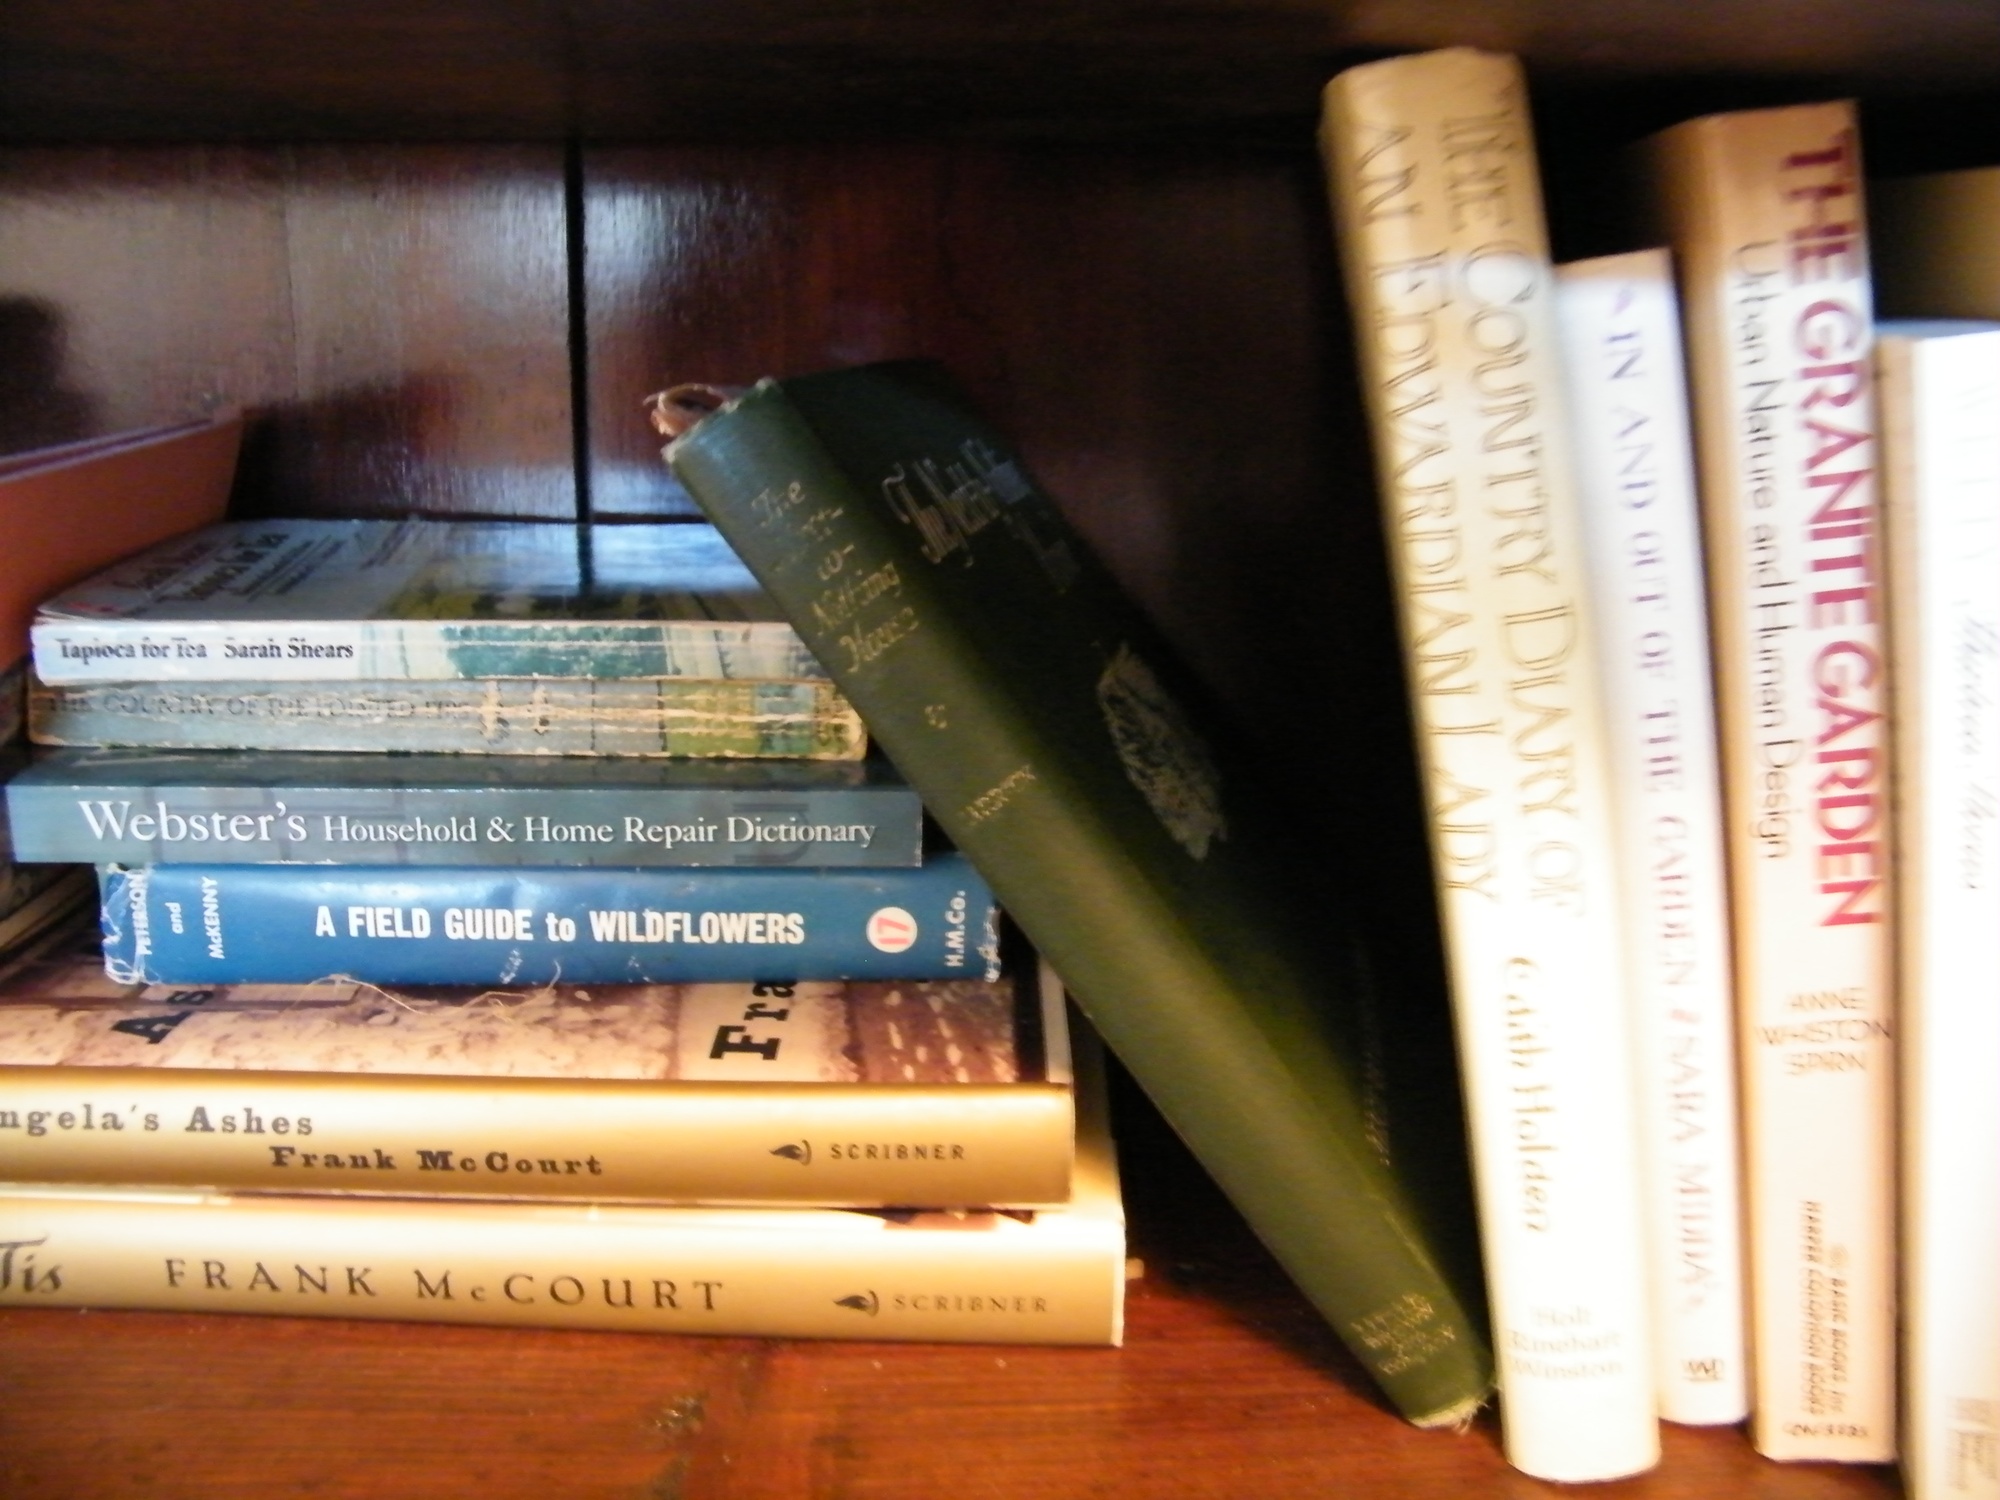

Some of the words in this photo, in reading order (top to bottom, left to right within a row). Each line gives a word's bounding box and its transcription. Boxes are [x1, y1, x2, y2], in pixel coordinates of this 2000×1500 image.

[1784, 126, 1859, 288] THE
[1728, 240, 1781, 368] Urban
[1612, 406, 1661, 510] AND
[1740, 376, 1786, 513] Nature
[1789, 300, 1877, 629] GRANITE
[1747, 524, 1795, 589] and
[58, 637, 137, 665] Tapioca
[141, 637, 169, 659] for
[172, 637, 207, 659] Tea
[224, 637, 282, 660] Sarah
[287, 637, 354, 661] Shears
[1754, 600, 1795, 730] Human
[1502, 602, 1579, 820] DIARY
[1751, 738, 1799, 860] Design
[1811, 639, 1884, 928] GARDEN
[77, 801, 307, 842] Webster's
[324, 816, 477, 843] Household
[487, 816, 515, 843] &
[524, 816, 614, 843] Home
[625, 815, 717, 848] Repair
[727, 814, 877, 848] Dictionary
[164, 902, 185, 935] and
[201, 875, 226, 960] McKENNY
[314, 905, 336, 937] A
[348, 906, 431, 938] FIELD
[444, 908, 534, 941] GUIDE
[546, 912, 576, 942] to
[589, 908, 805, 945] WILDFLOWERS
[877, 914, 910, 946] 17
[185, 1105, 313, 1136] Ashes
[830, 1143, 966, 1161] SCRIBNER
[1507, 1082, 1560, 1234] Holden
[269, 1145, 398, 1169] Frank
[417, 1149, 602, 1176] McCourt
[165, 1257, 377, 1297] FRANK
[413, 1268, 723, 1312] McCOURT
[892, 1294, 1048, 1315] SCRIBNER
